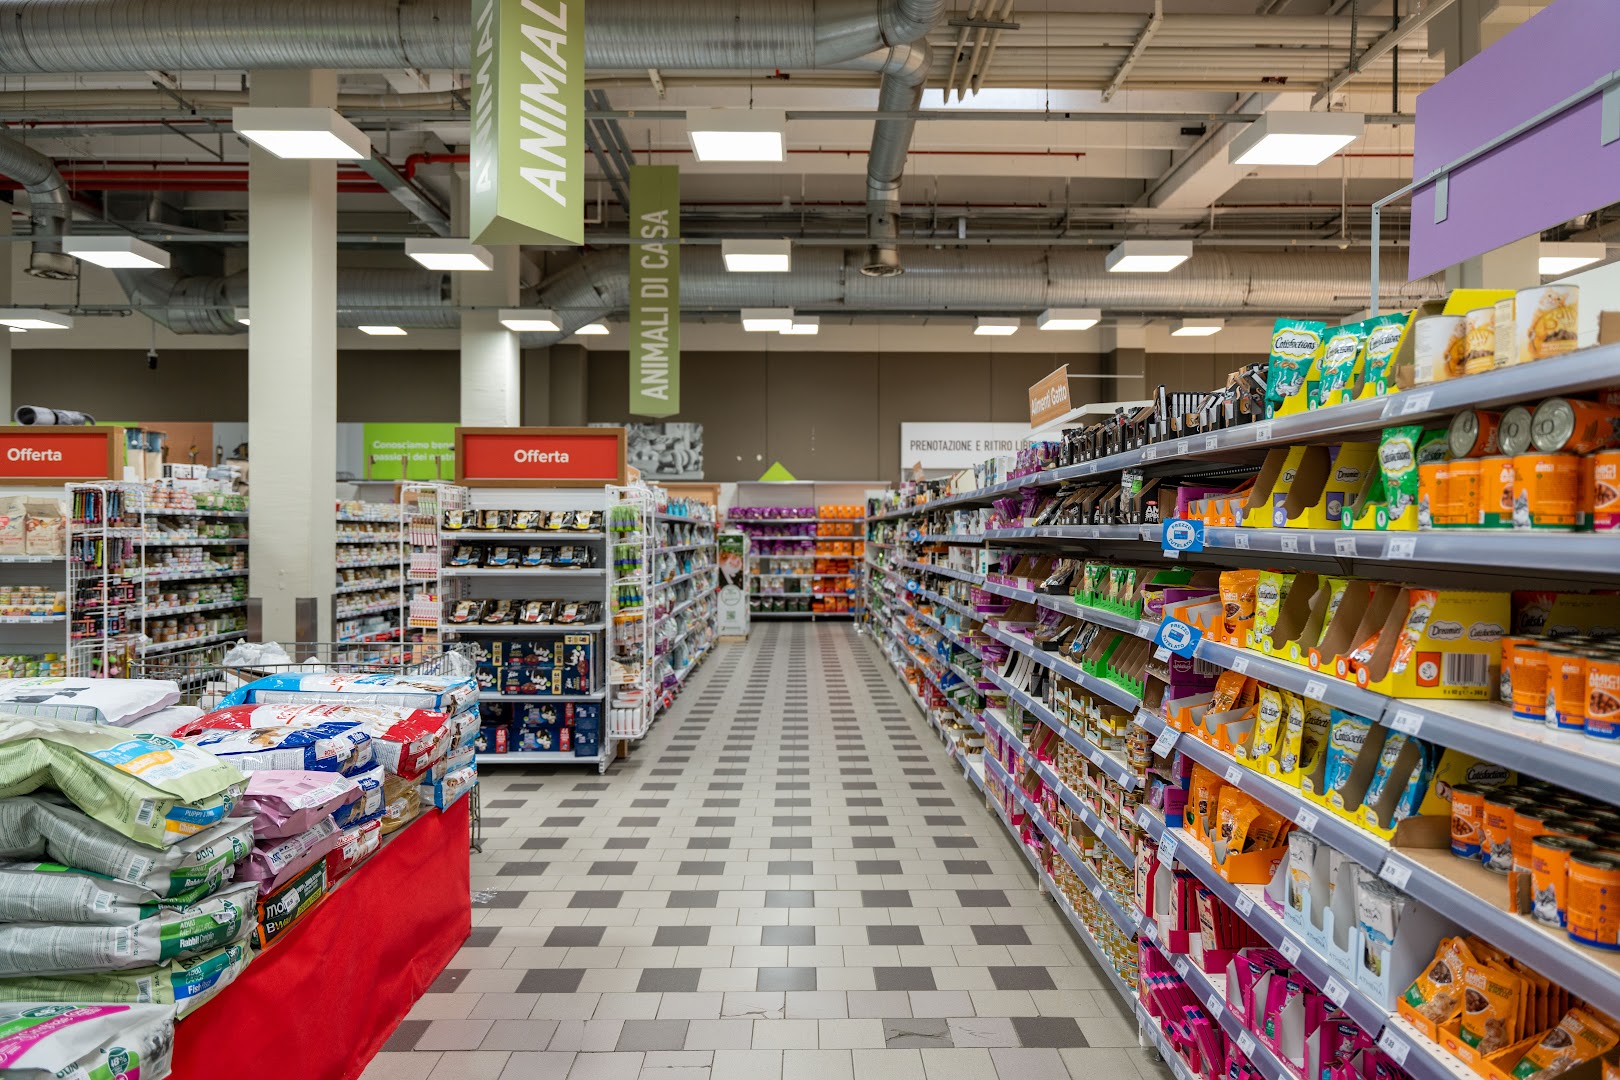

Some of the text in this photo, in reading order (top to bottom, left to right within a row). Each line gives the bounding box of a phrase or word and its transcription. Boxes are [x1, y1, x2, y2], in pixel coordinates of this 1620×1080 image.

[641, 210, 669, 400] ANIMALI DI CASA
[1031, 384, 1067, 416] Alimenti Gatto
[373, 440, 429, 449] Conosciamo
[910, 440, 972, 451] PRENOTAZIONE
[976, 440, 981, 451] E
[984, 440, 1012, 451] RITIRO
[7, 447, 62, 462] Offerta
[514, 449, 569, 463] Offerta
[1171, 522, 1192, 531] PREZZO
[1168, 538, 1193, 548] TUTELATO
[1170, 623, 1190, 636] PREZZO
[1162, 634, 1185, 649] TUTELATO
[180, 935, 200, 948] Rabbit
[187, 981, 201, 995] Fish
